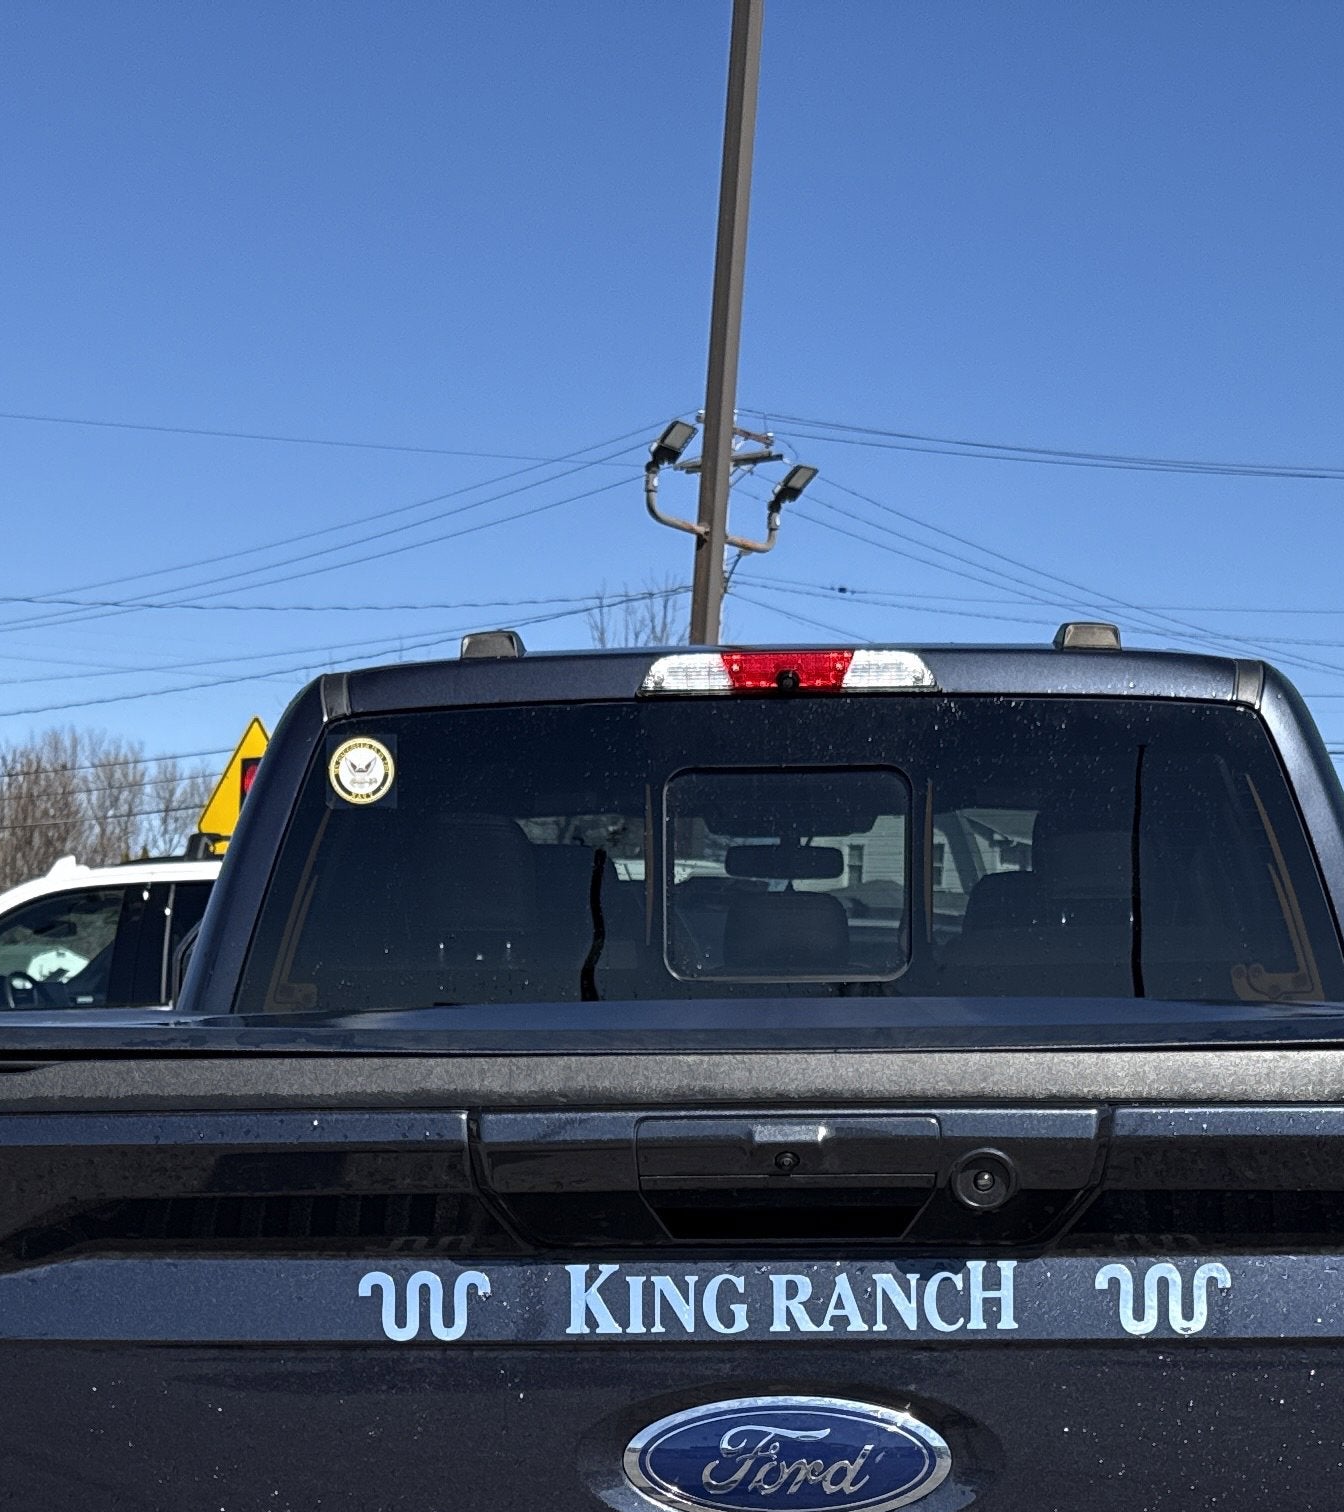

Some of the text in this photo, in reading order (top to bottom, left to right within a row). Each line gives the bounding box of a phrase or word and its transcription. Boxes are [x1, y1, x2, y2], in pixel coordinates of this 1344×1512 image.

[565, 1260, 1019, 1336] KING RANCH
[701, 1423, 876, 1498] Ford
